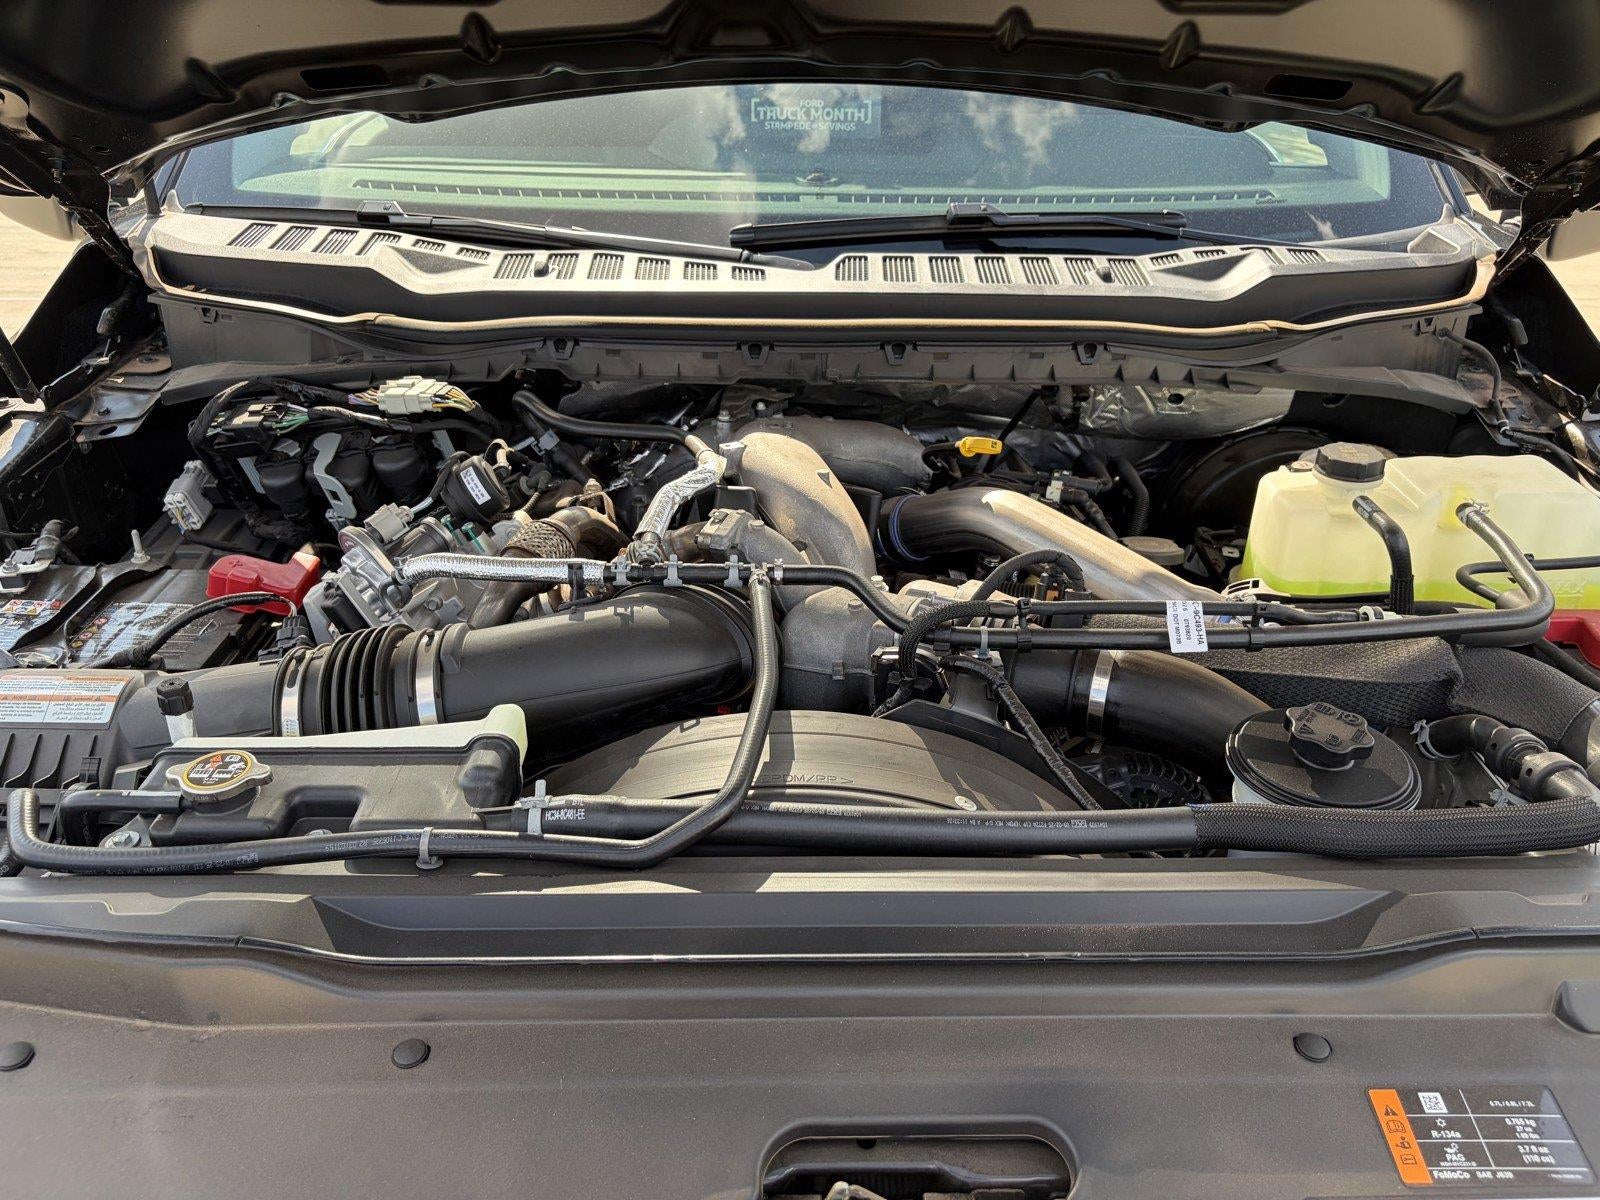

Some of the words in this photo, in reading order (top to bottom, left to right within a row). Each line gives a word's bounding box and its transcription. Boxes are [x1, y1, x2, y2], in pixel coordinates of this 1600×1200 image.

[799, 99, 825, 108] FORD
[756, 107, 807, 121] TRUCK
[810, 107, 866, 122] MONTH
[764, 121, 811, 131] STAMPEDE
[818, 122, 857, 131] SAVINGS
[1430, 1130, 1462, 1138] R-134a
[1445, 1153, 1466, 1162] PAG
[1432, 1170, 1471, 1179] FoMoCo
